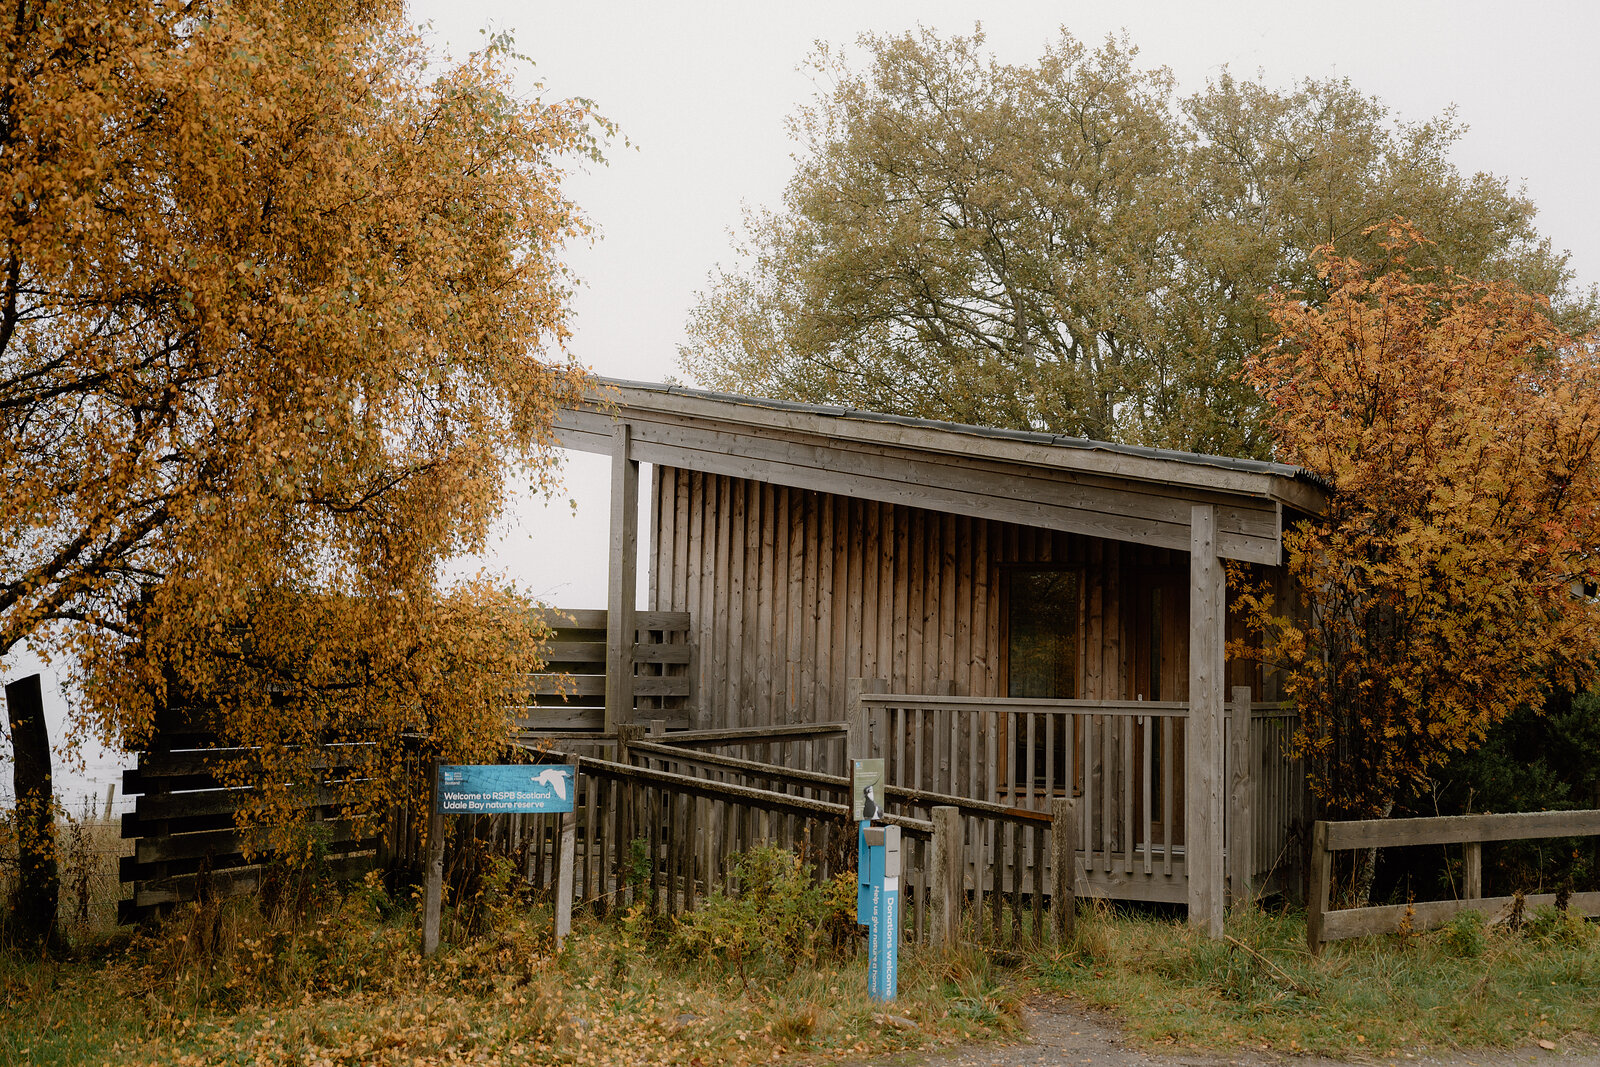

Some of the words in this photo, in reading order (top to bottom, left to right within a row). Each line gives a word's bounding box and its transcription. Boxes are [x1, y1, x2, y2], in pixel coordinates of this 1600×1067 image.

[444, 792, 481, 801] Welcome
[482, 792, 491, 800] to
[492, 791, 515, 800] RSPB
[516, 791, 551, 800] Scotland
[443, 801, 468, 809] Udale
[469, 801, 485, 810] Bay
[485, 801, 512, 809] nature
[513, 801, 545, 809] reserve
[873, 905, 879, 915] us
[871, 916, 879, 933] give
[886, 897, 894, 948] Donations
[886, 950, 894, 997] welcome
